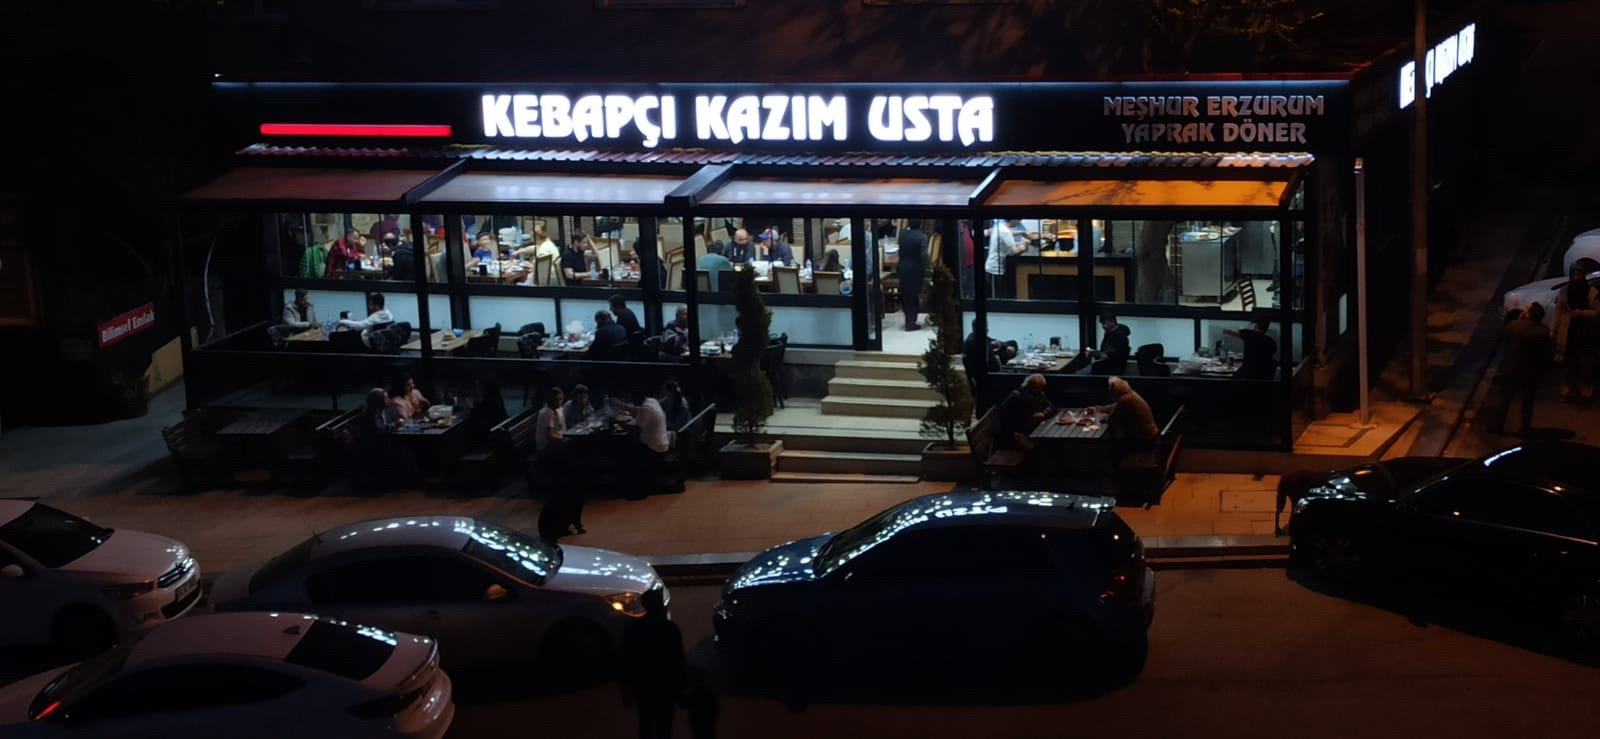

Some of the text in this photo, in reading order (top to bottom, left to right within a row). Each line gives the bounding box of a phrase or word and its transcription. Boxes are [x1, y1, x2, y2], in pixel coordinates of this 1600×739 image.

[1103, 94, 1325, 119] MEŞHUR ERZURUM
[480, 93, 994, 149] KEBAPÇI KAZIM USTA
[1121, 119, 1308, 144] YAPRAK DÖNER
